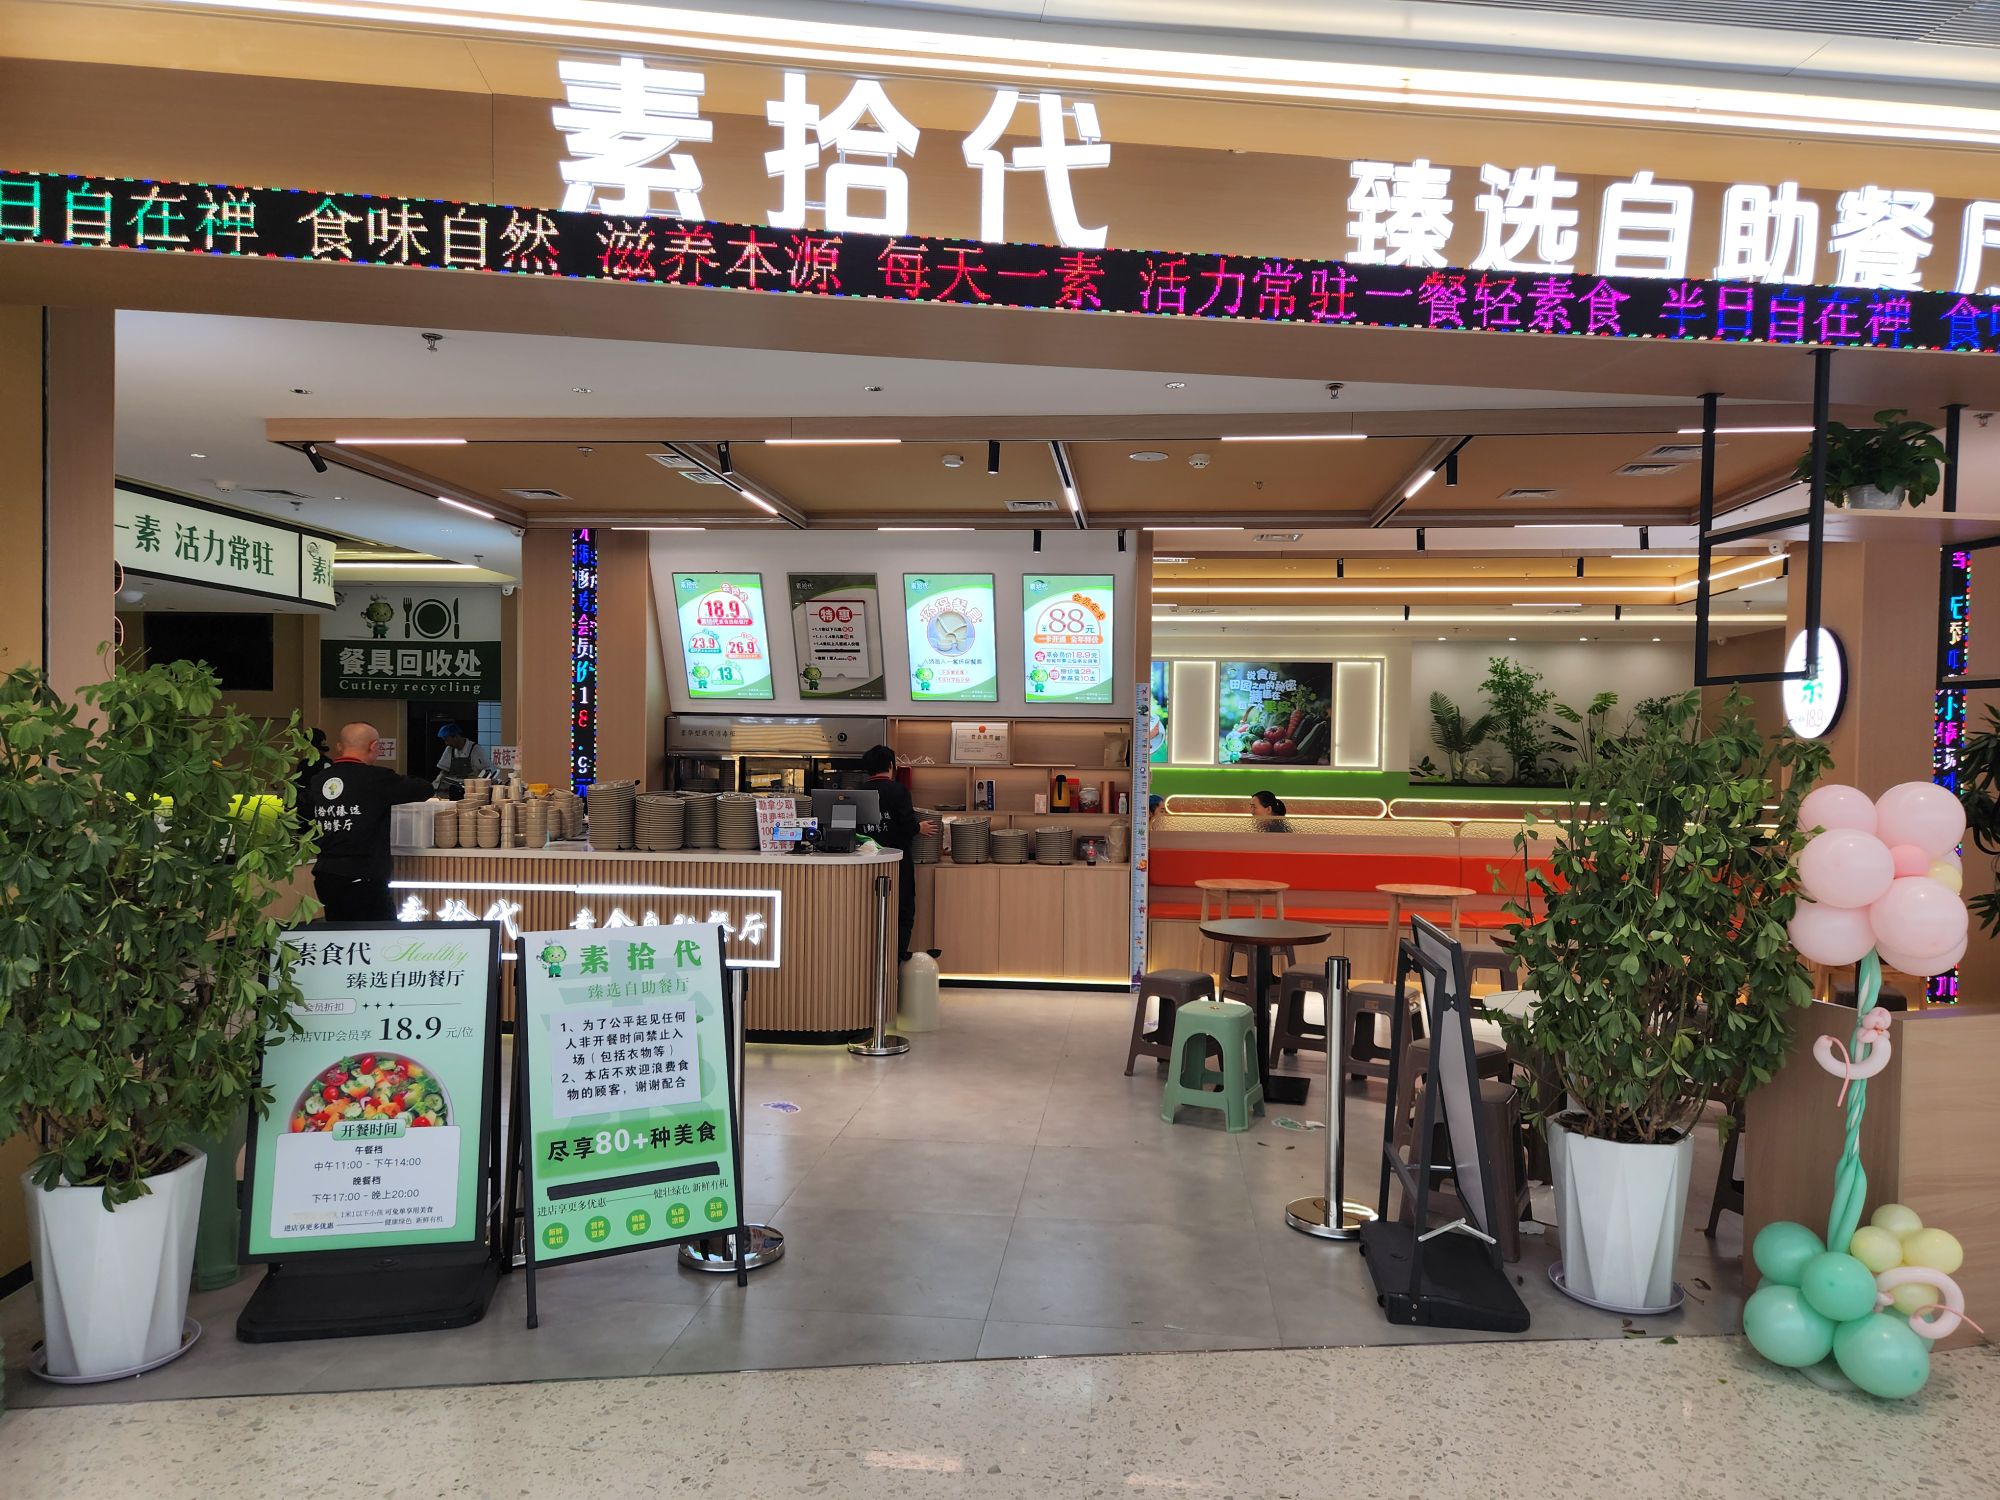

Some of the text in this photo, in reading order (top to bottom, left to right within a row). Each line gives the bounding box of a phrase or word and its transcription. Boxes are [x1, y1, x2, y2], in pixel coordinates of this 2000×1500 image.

[552, 57, 1110, 249] 素拾代
[297, 198, 559, 271] 食味自然
[597, 220, 843, 289] 滋养本源
[878, 239, 1104, 308] 每天一素
[1659, 281, 1912, 348] 半日自在禅
[175, 522, 274, 576] 活力常驻
[704, 600, 740, 618] 18.9
[819, 608, 851, 622] 特惠
[920, 597, 982, 624] 环保餐具
[692, 637, 715, 649] 23.9
[729, 641, 754, 653] 26.9
[339, 648, 482, 677] 餐具回收处
[718, 667, 733, 680] 13
[339, 680, 481, 696] Cutlery recycling
[293, 935, 470, 967] 素食代 Healthy
[579, 939, 702, 975] 素拾代
[346, 969, 465, 989] 臻选自助餐厅
[588, 977, 689, 1000] 臻选自助餐厅
[378, 1016, 442, 1040] 18.9
[446, 1026, 473, 1038] 元/位
[561, 1011, 686, 1033] 1、为了公平起见任何
[565, 1028, 683, 1050] 人非开餐时间禁止入
[562, 1060, 689, 1084] 2、本店不欢迎浪费食
[567, 1076, 687, 1101] 物的顾客，谢谢配合
[341, 1122, 397, 1138] 开餐时间
[548, 1120, 716, 1162] 尽享80+种美食
[355, 1145, 383, 1155] 午餐档
[352, 1176, 381, 1186] 晚餐档
[537, 1197, 608, 1217] 进店享更多优惠
[692, 1179, 729, 1192] 新鲜有机
[284, 1223, 334, 1232] 进店享更多优惠
